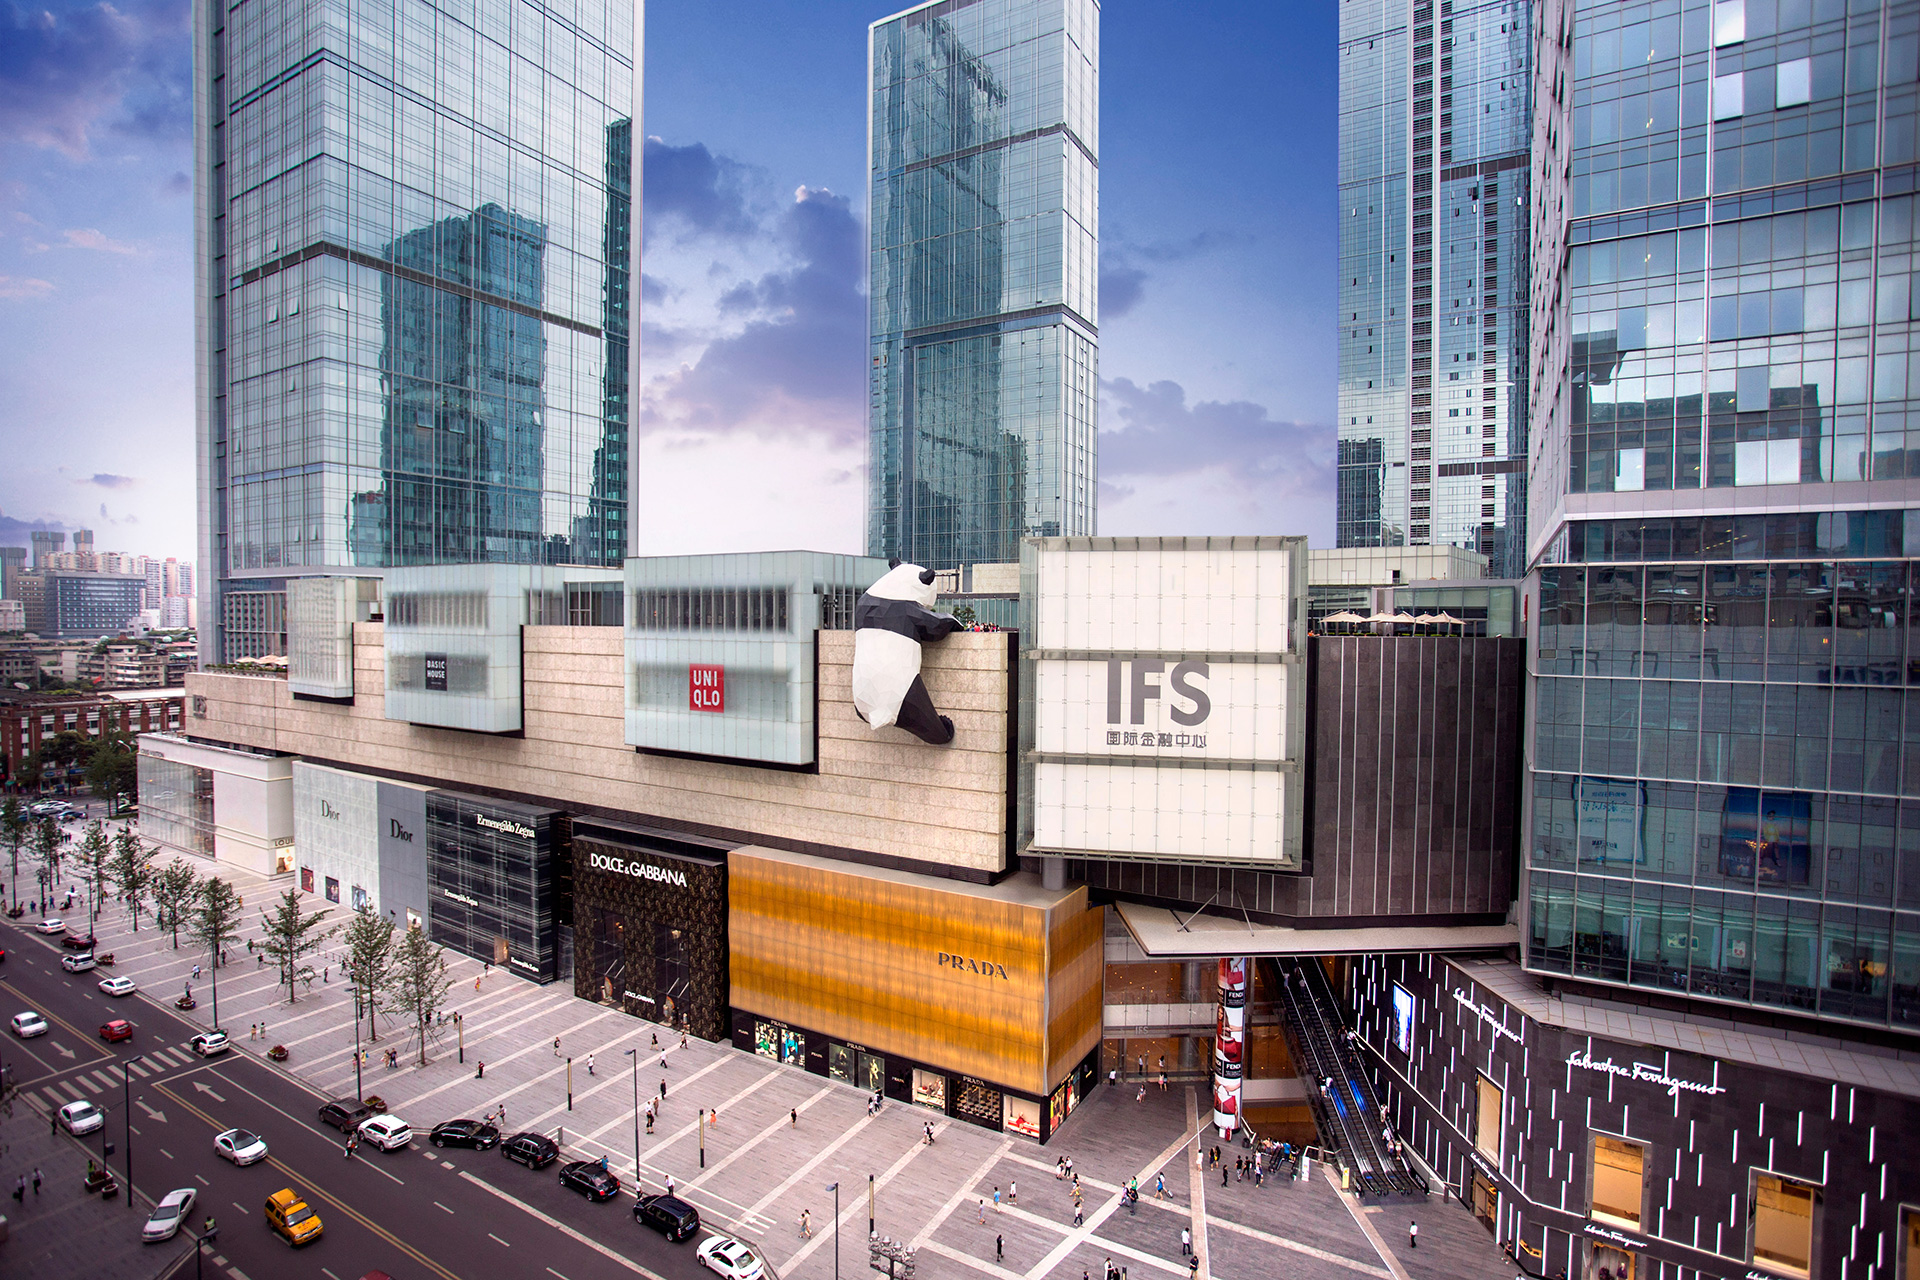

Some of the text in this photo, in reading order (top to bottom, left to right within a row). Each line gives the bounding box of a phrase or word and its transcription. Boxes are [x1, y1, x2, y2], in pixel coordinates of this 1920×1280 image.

[427, 660, 445, 669] BASIC
[427, 670, 445, 678] HOUSE
[693, 670, 717, 687] UNI
[693, 689, 720, 707] QLO
[1106, 659, 1211, 726] IFS
[1106, 731, 1207, 748] 国际金融中心
[321, 799, 340, 820] Dior
[390, 818, 413, 842] Dior
[477, 814, 535, 838] Ermenegildo Zegna
[938, 951, 1009, 981] PRADA
[846, 1042, 866, 1052] PRADA
[962, 1075, 985, 1087] PRADA
[1565, 1051, 1727, 1096] Salvatore Ferragamo
